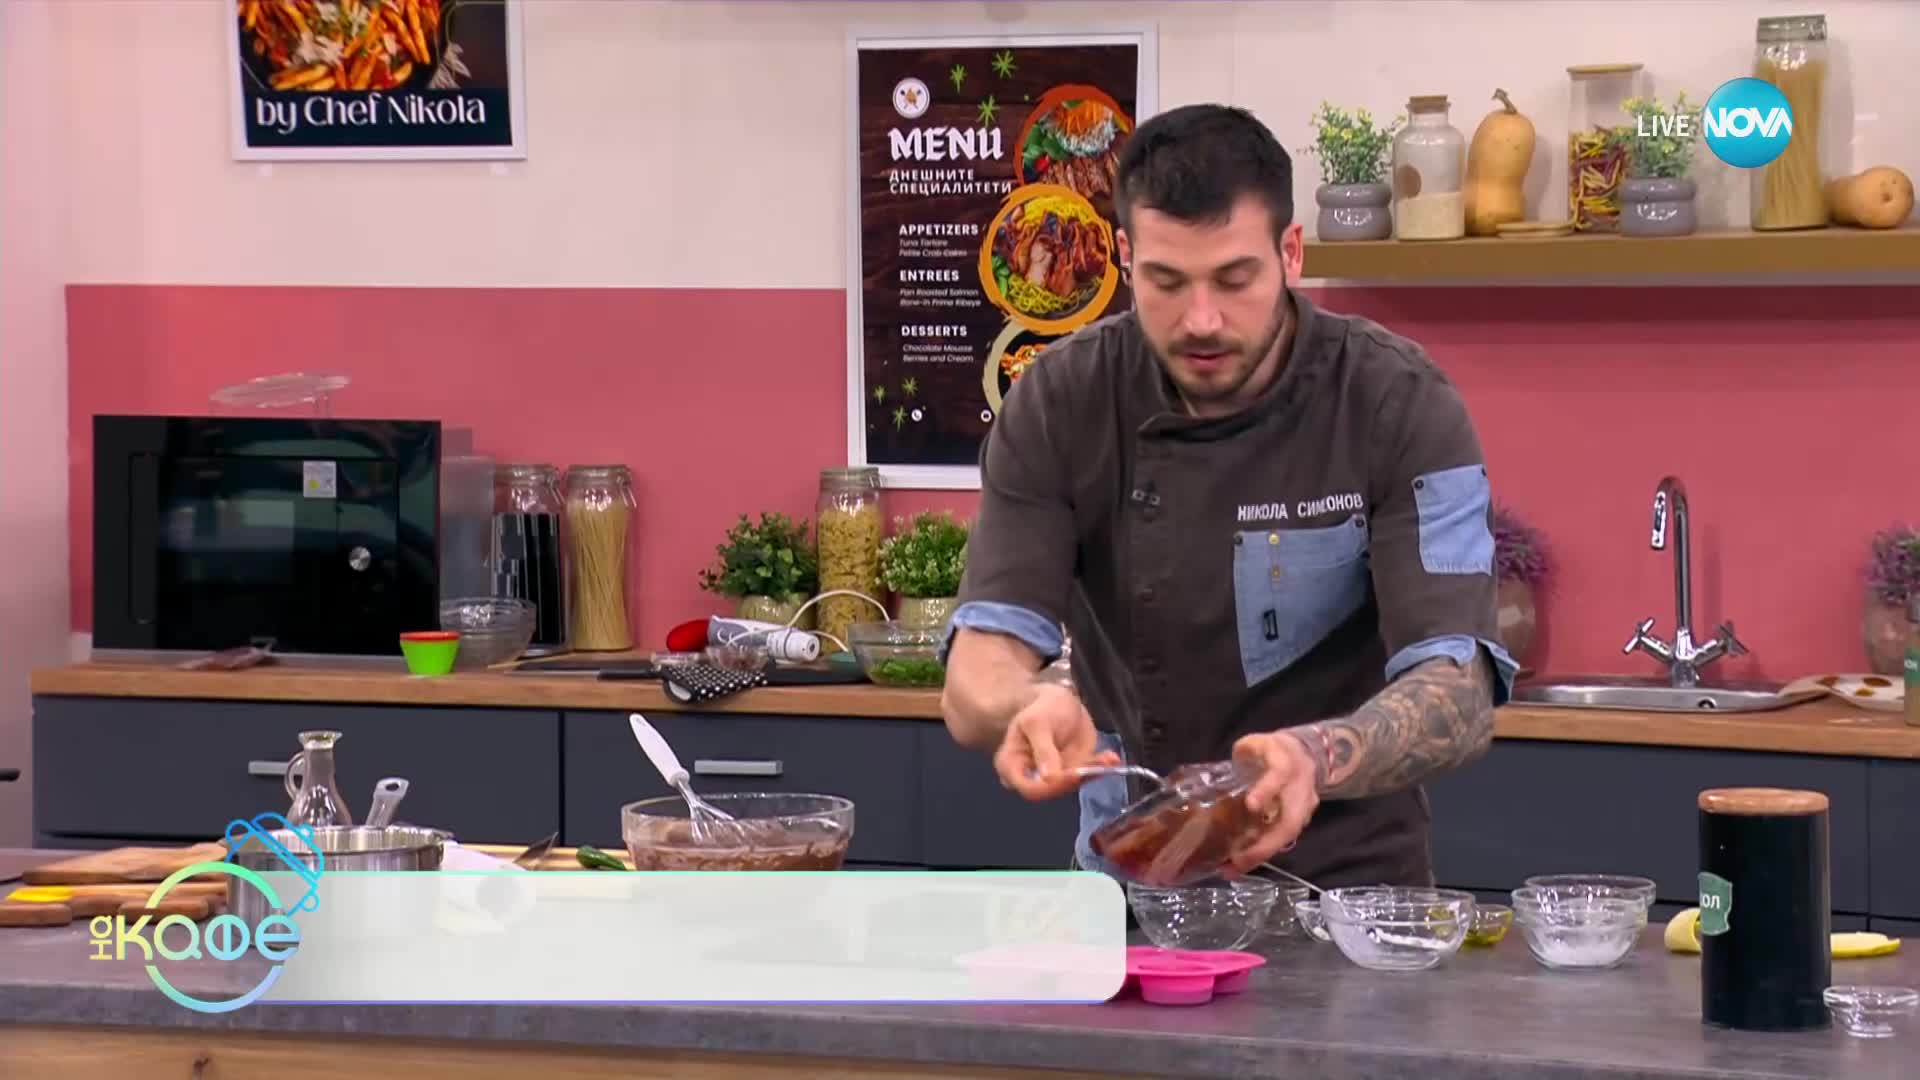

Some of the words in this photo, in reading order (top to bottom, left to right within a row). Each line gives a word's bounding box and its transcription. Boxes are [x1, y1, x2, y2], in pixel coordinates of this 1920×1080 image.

[256, 97, 296, 134] by
[304, 92, 380, 126] Chef
[388, 95, 486, 125] Nikola
[888, 126, 1003, 161] MENU
[889, 168, 975, 184] ДНЕШНИТЕ
[889, 181, 1012, 197] СПЕЦИАЛИТЕТИ
[899, 223, 979, 236] APPETIZERS
[899, 269, 960, 282] ENTREES
[916, 287, 948, 296] Roasted
[949, 287, 979, 296] Salmon
[901, 325, 968, 337] DESSERTS
[902, 343, 943, 353] Chocolate
[943, 344, 973, 353] Mousse
[903, 354, 929, 363] Berries
[930, 354, 946, 363] and
[947, 354, 974, 363] Cream
[1237, 503, 1289, 521] НИКОЛА
[1297, 493, 1364, 518] СИМОНОВ
